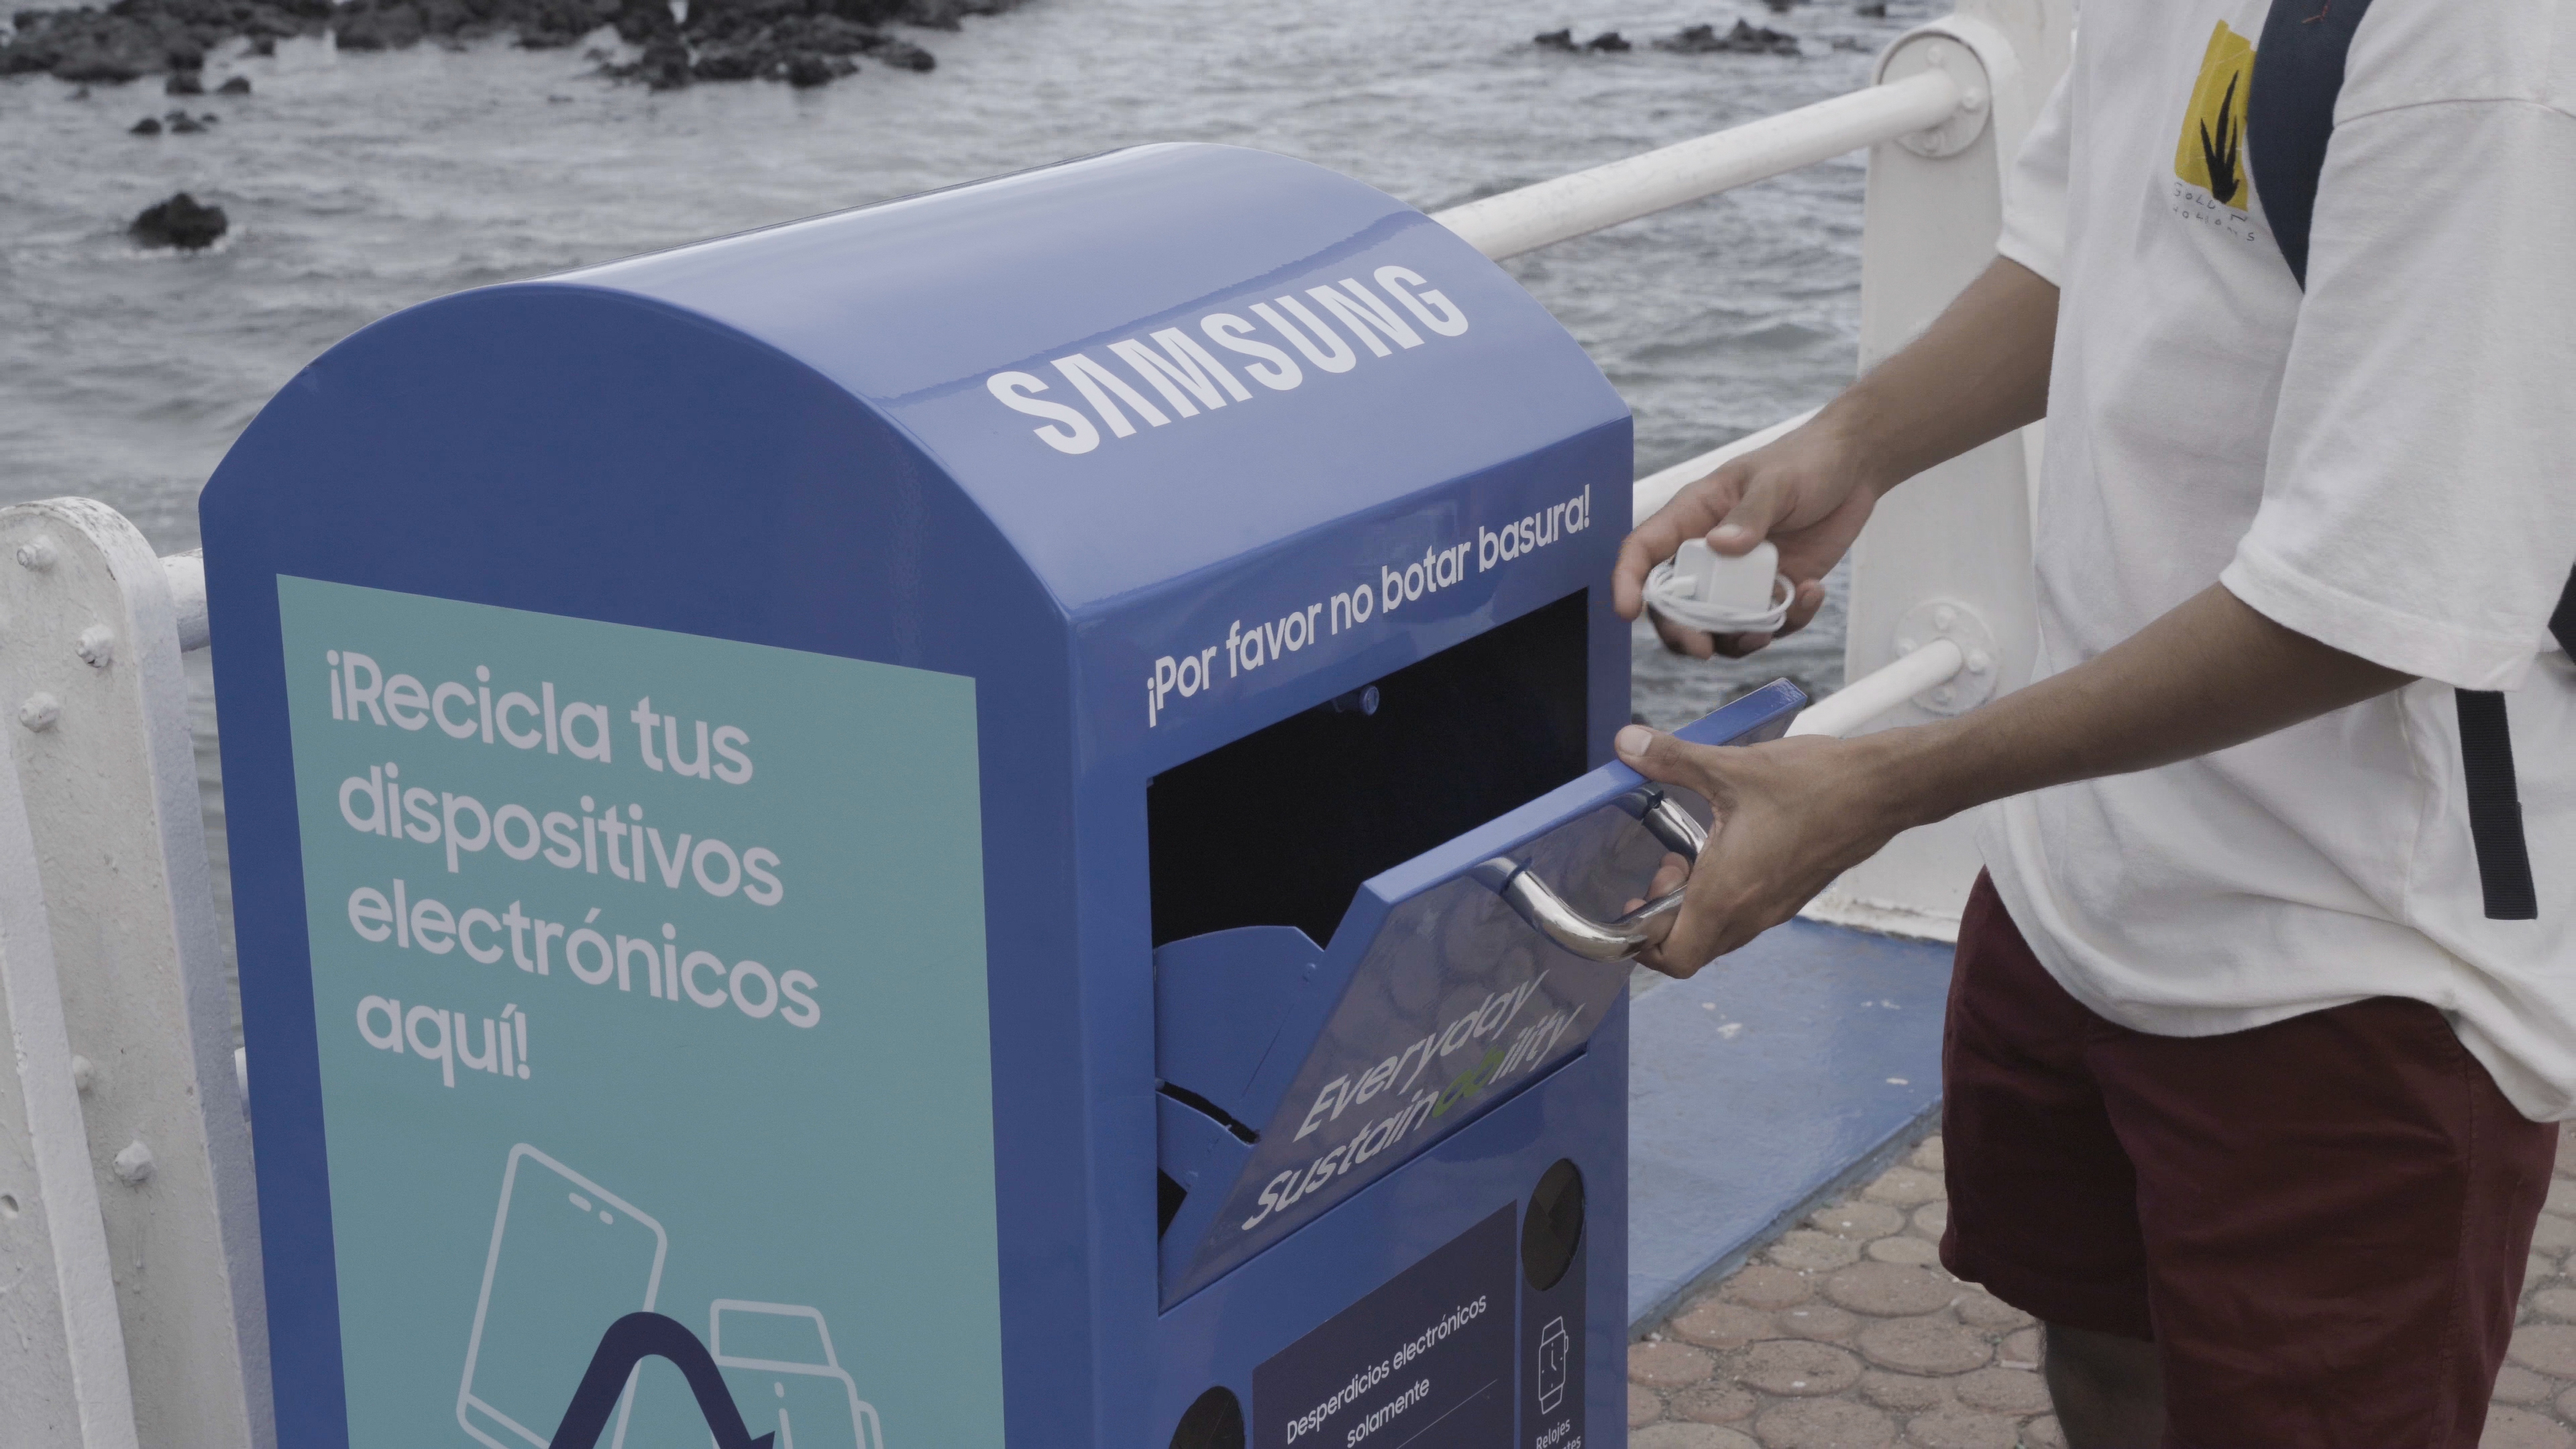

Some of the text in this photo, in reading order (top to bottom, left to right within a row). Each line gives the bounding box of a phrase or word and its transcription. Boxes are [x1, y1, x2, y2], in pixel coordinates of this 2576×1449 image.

[986, 266, 1468, 454] SAMSUNG
[1147, 484, 1590, 728] ¡Por favor no botar basura!
[327, 649, 753, 784] ¡Recicla tus
[339, 761, 784, 906] dispositivos
[347, 878, 820, 1028] electrónicos
[356, 994, 531, 1088] aquí!
[1293, 969, 1550, 1142] Everyday
[1287, 1295, 1487, 1445] Desperdicios electrónicos
[1347, 1379, 1430, 1448] solamente
[1536, 1419, 1570, 1449] Relojes
